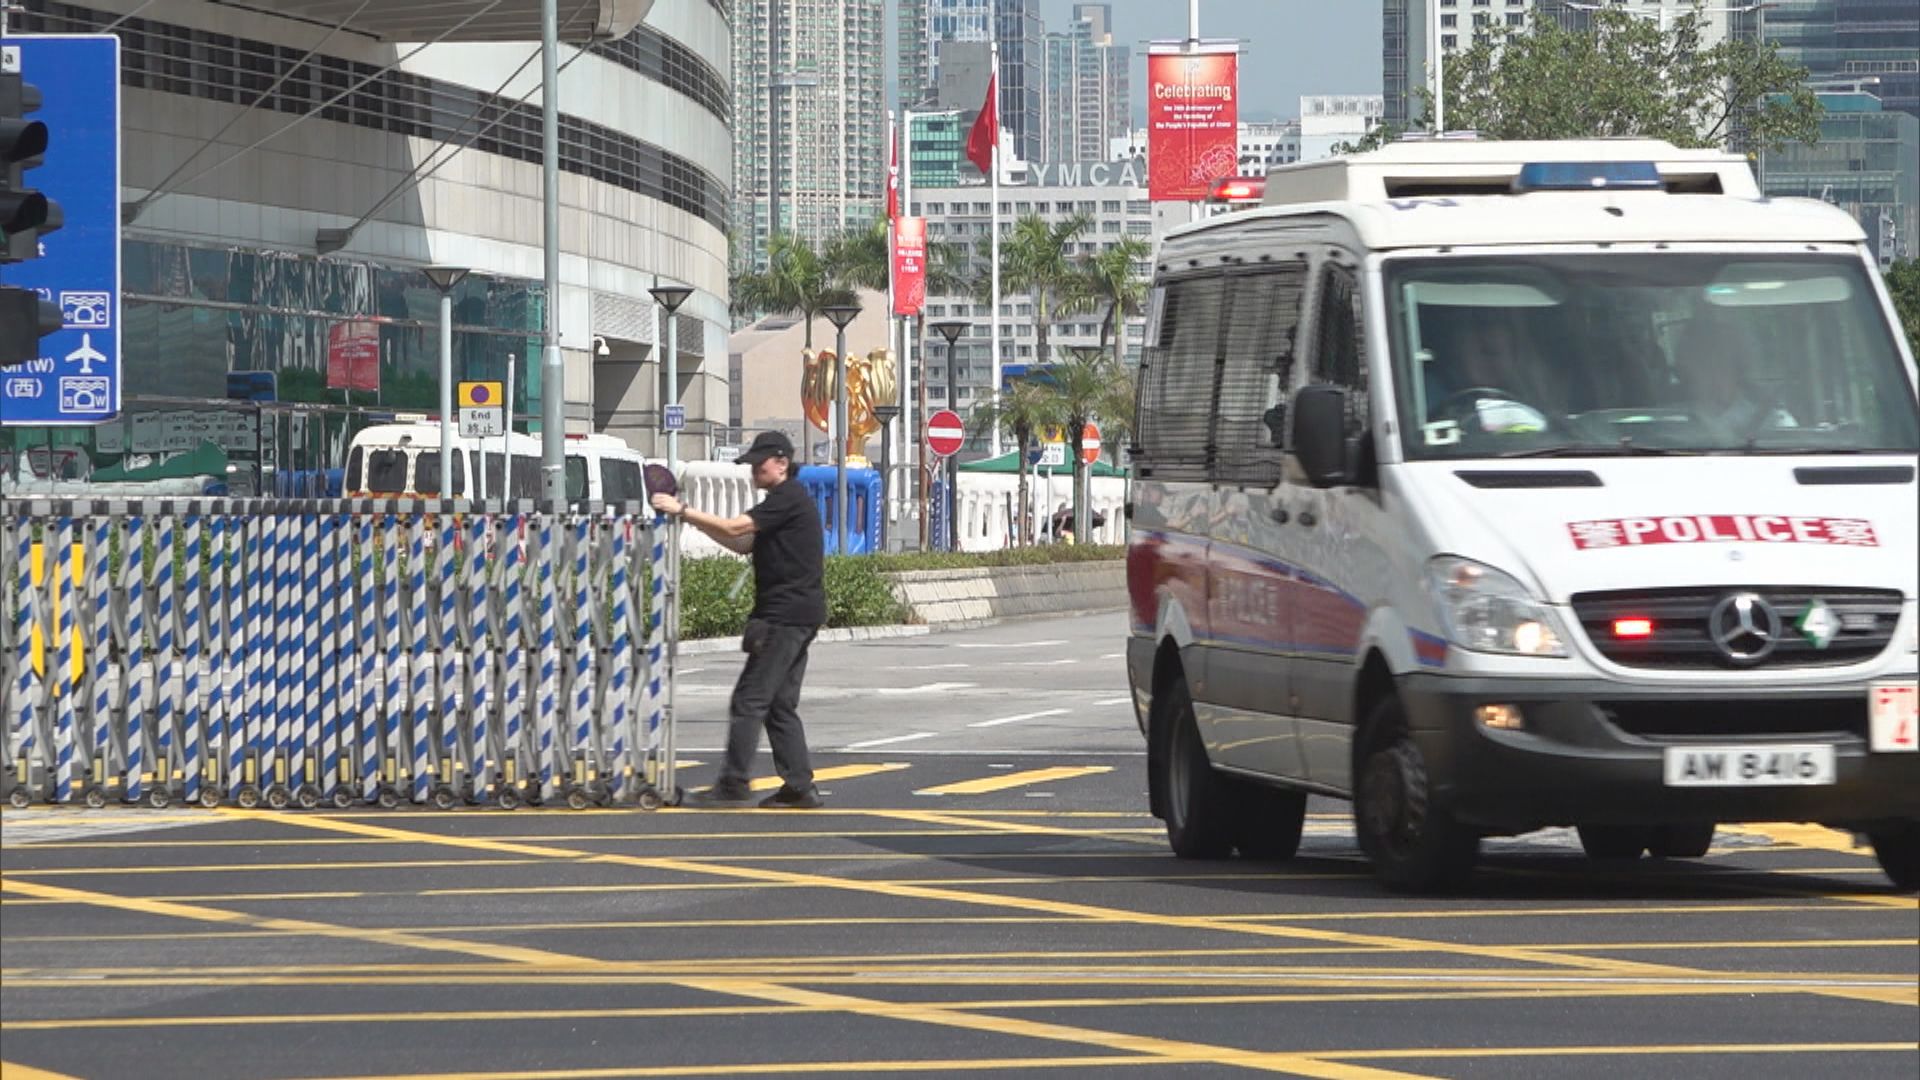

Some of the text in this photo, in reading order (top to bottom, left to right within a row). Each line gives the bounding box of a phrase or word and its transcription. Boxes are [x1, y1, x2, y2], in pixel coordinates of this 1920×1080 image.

[1154, 82, 1232, 101] Celebrating
[1030, 163, 1139, 187] YMCA
[96, 310, 105, 322] C
[26, 358, 55, 373] (W)
[5, 378, 42, 398] (西)
[95, 396, 105, 407] W
[471, 410, 491, 420] End
[467, 423, 494, 434] 終止
[1621, 516, 1828, 545] POLICE
[1680, 752, 1817, 780] AW 8416
